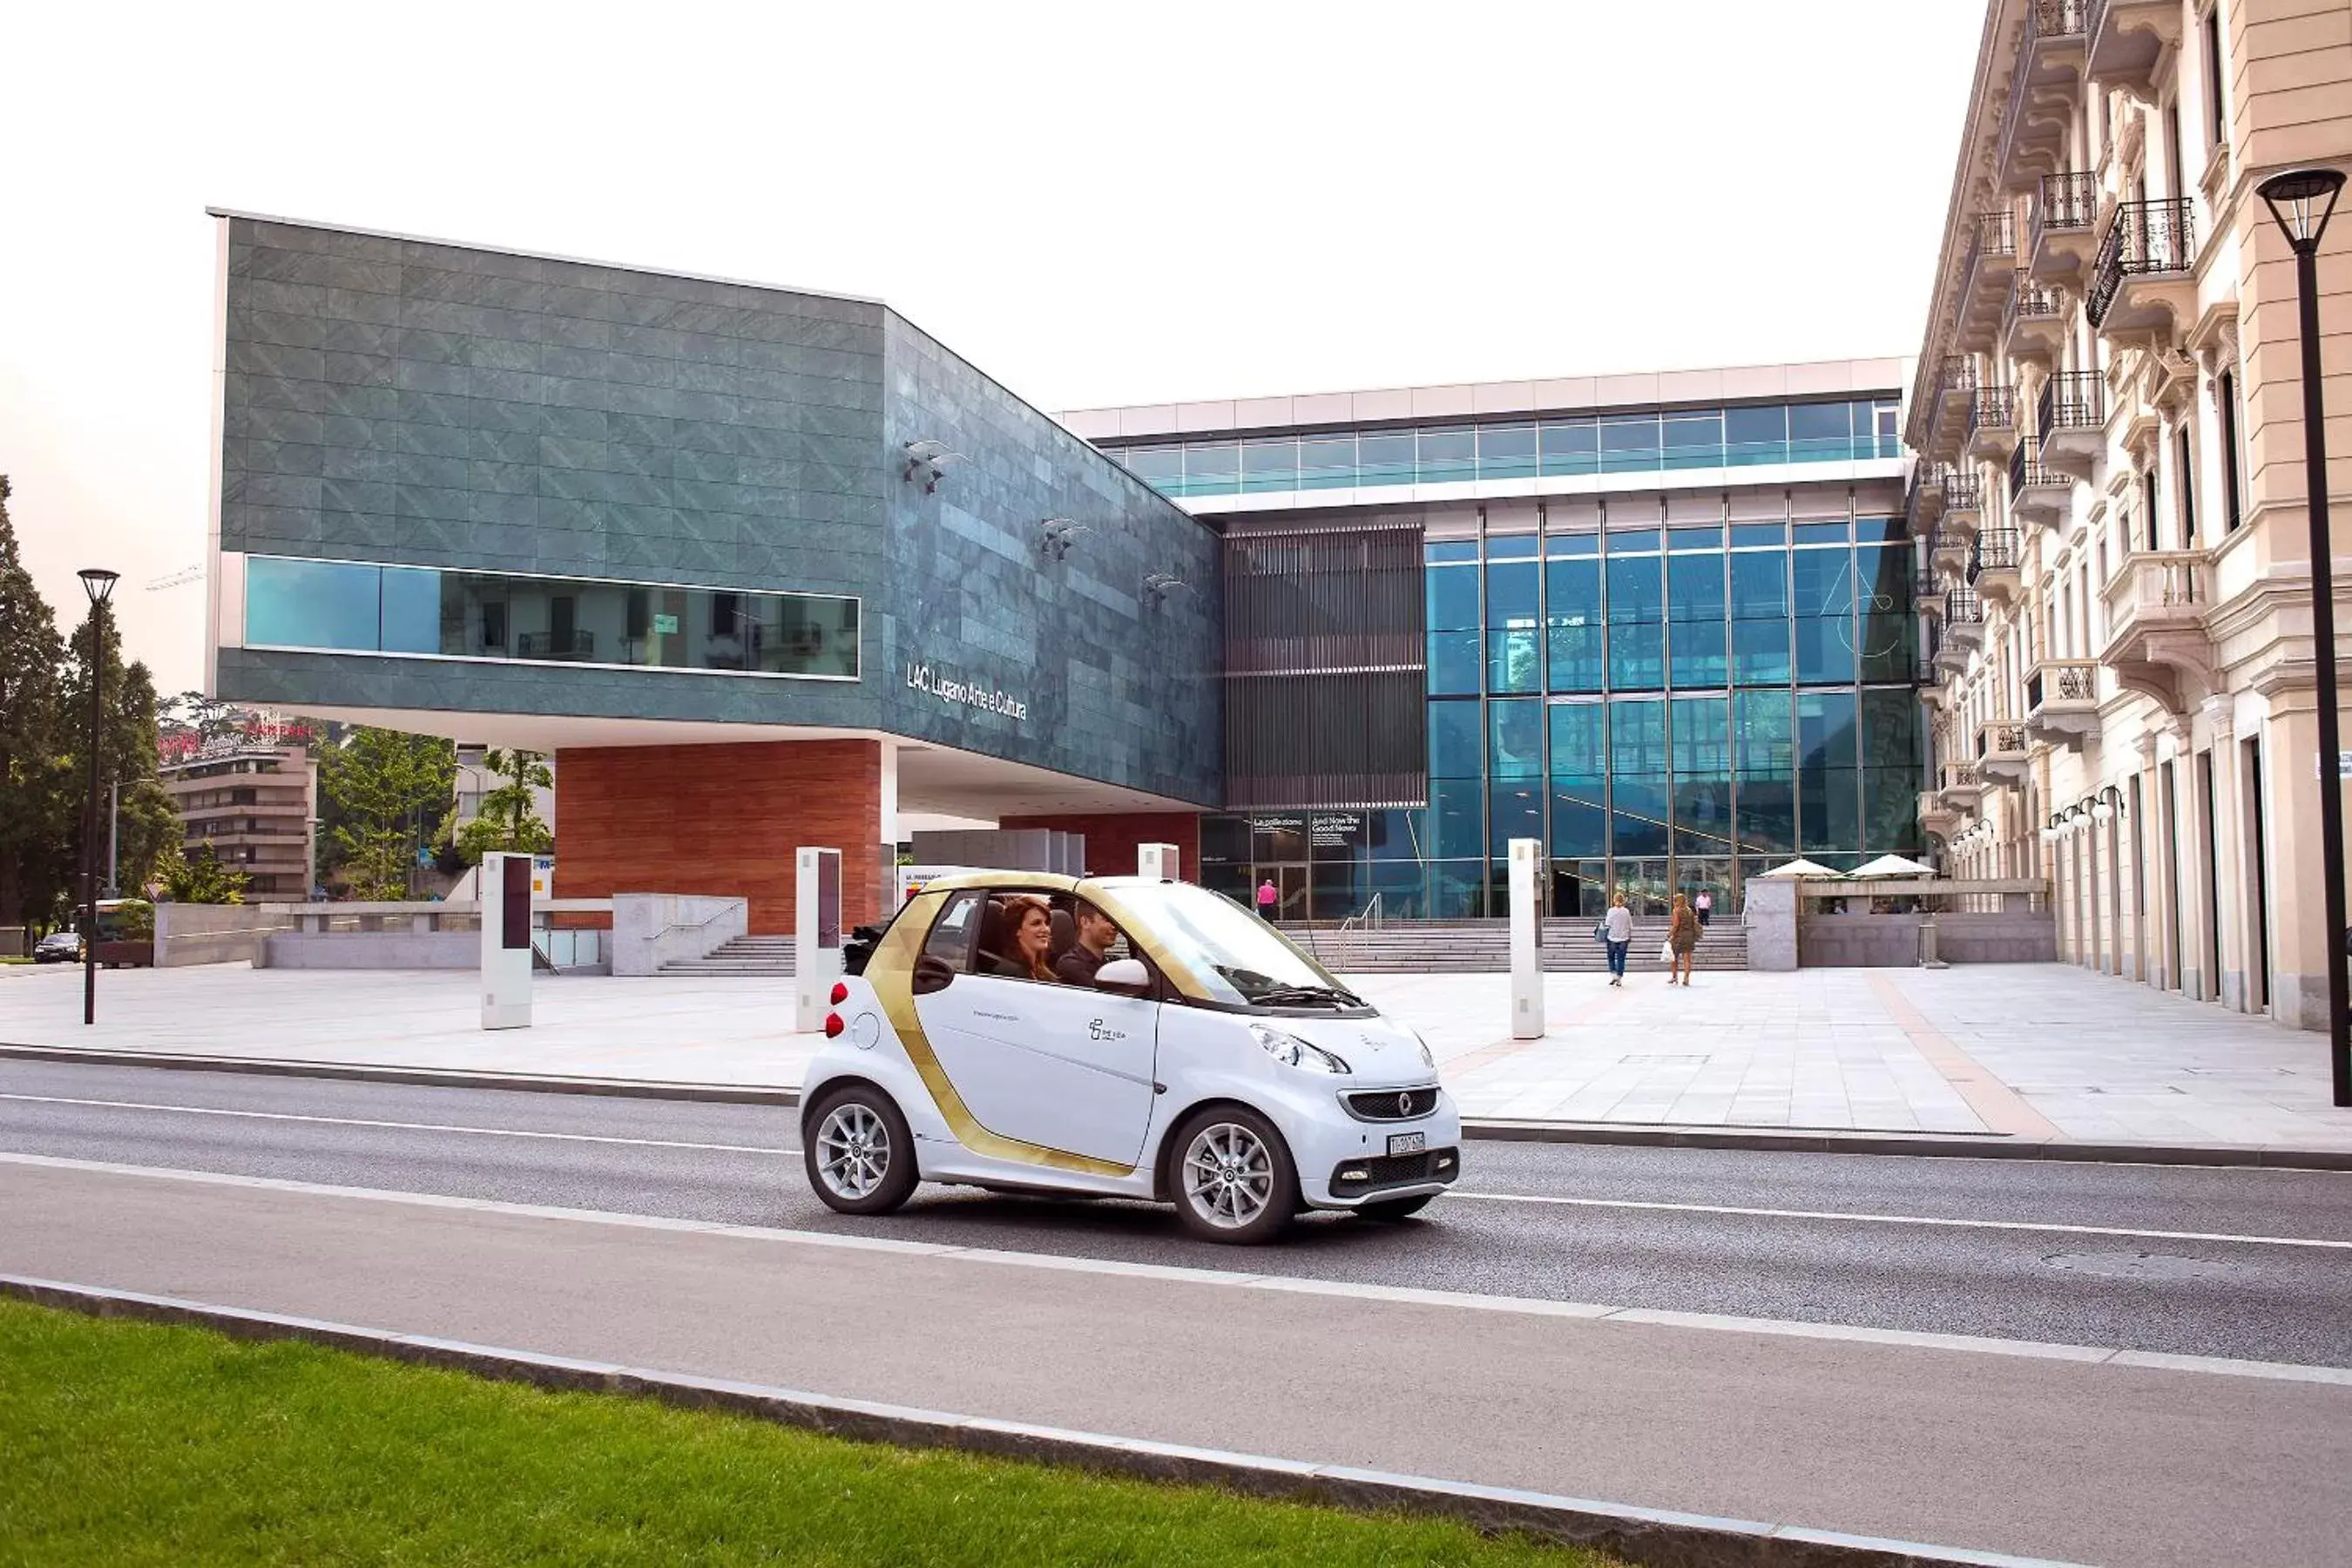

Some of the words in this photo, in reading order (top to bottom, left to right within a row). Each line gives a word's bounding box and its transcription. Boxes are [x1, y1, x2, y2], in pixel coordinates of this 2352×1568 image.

[907, 661, 929, 691] LAC
[932, 669, 967, 702] Lugano
[968, 682, 987, 708] Arte
[989, 693, 995, 711] e
[995, 689, 1026, 720] Cultura
